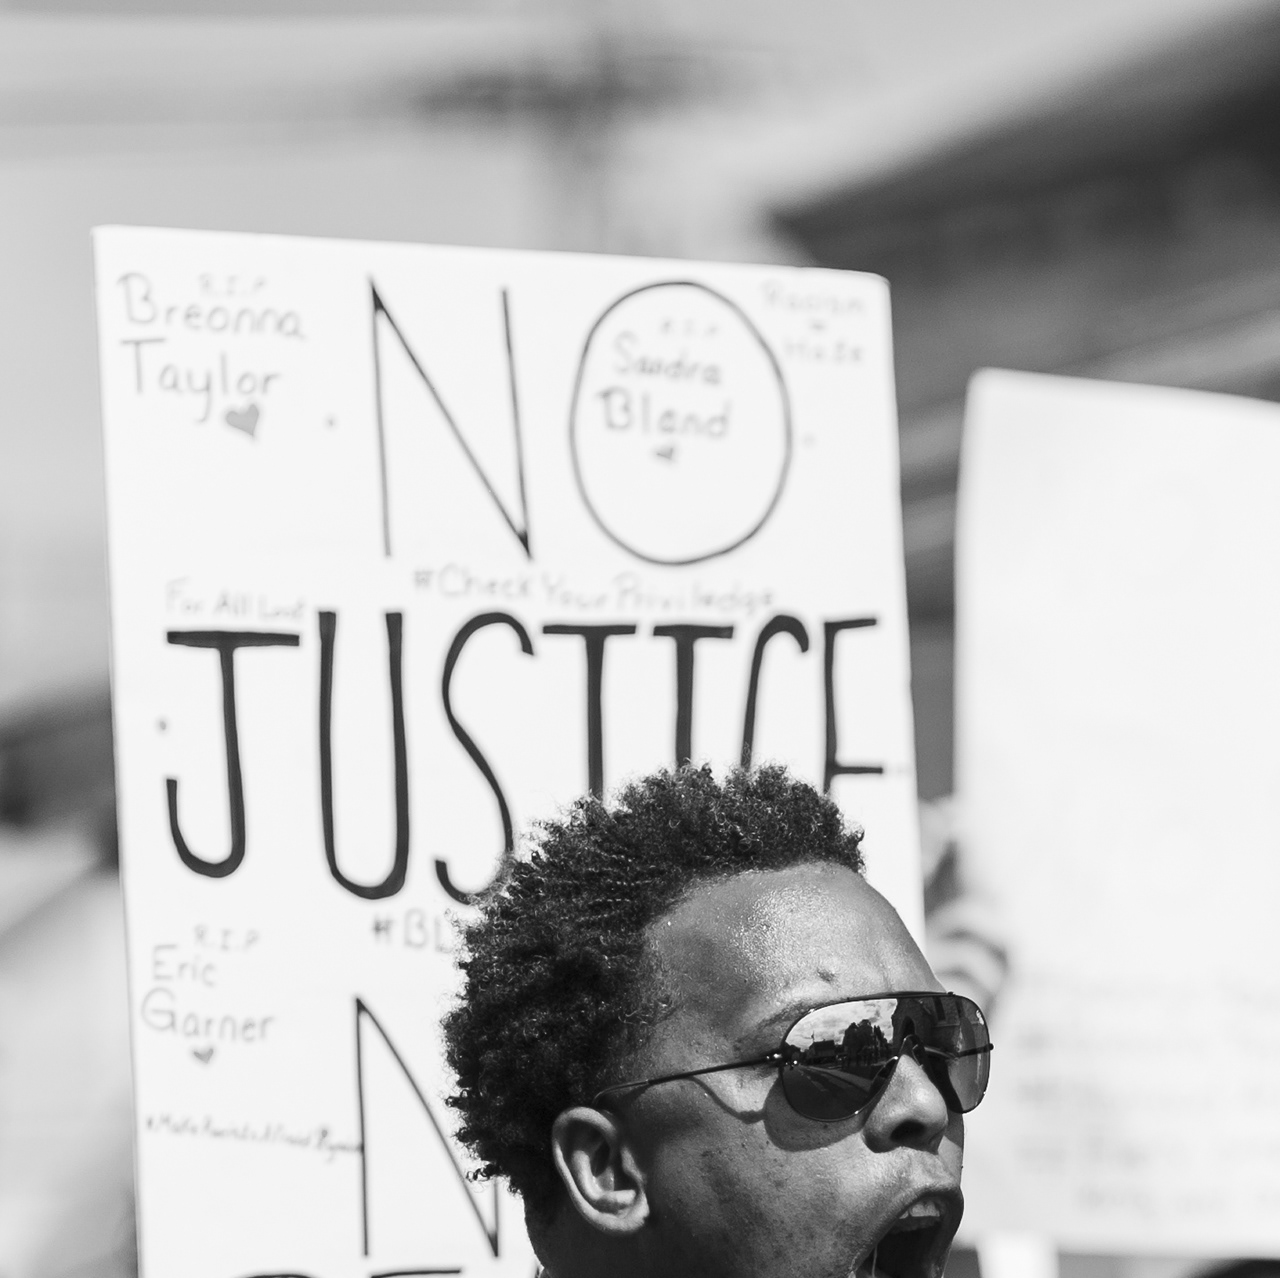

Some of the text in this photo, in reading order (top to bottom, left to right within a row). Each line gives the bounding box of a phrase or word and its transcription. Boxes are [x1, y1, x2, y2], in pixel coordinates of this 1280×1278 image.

[117, 272, 308, 342] Breonna
[119, 337, 282, 424] Taylor
[592, 384, 735, 442] Bland
[367, 275, 793, 566] NO
[165, 607, 885, 904] JUSTICE
[151, 942, 218, 988] Eric
[140, 985, 276, 1044] Garner
